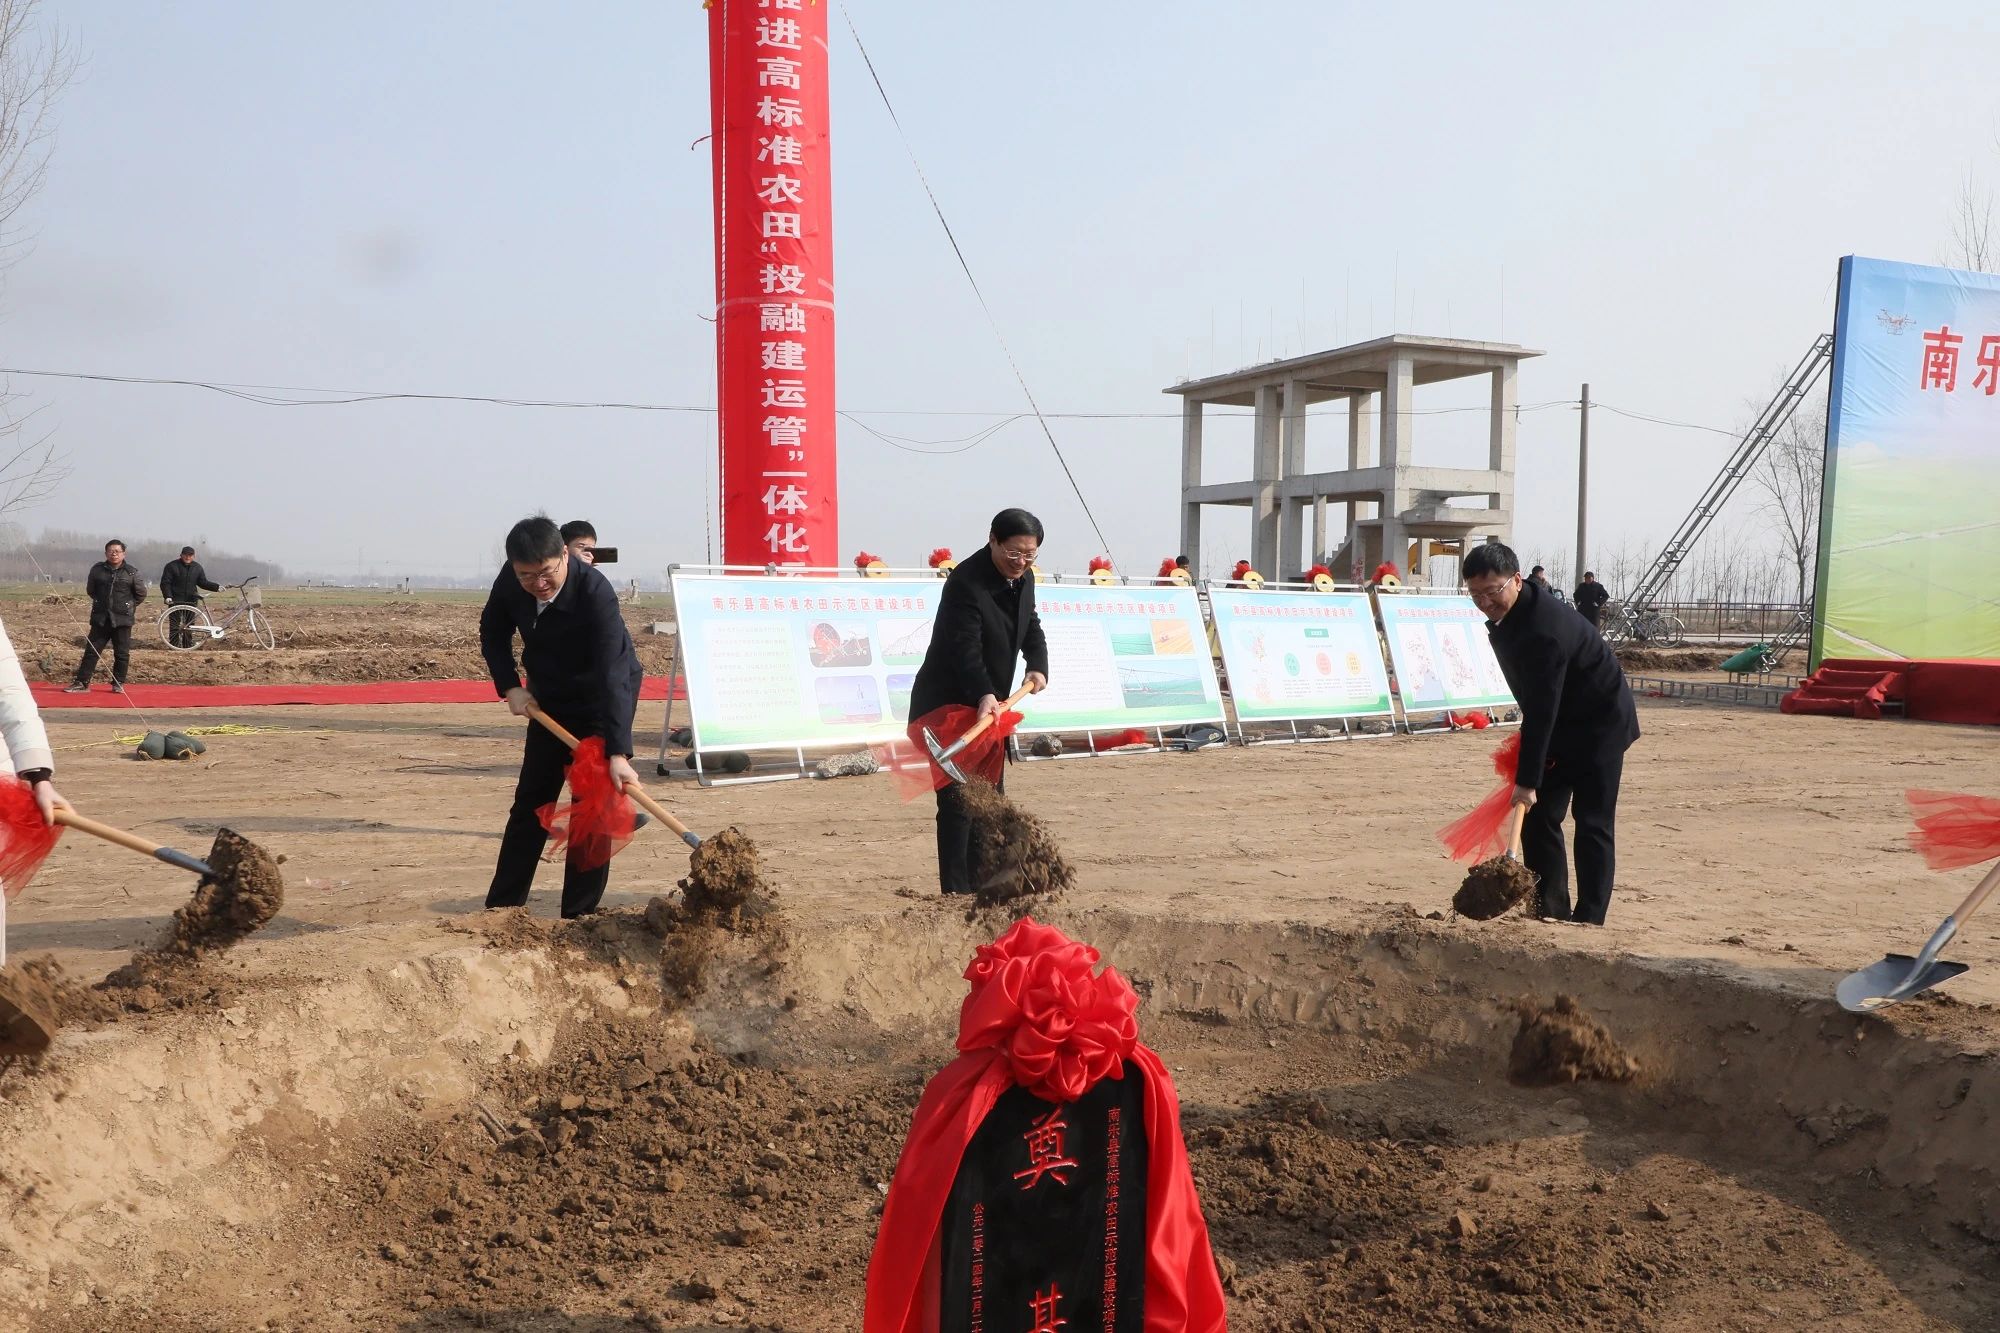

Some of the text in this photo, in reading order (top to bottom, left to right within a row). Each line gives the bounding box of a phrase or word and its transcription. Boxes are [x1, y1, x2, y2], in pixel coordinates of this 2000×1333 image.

[712, 596, 926, 611] 南乐县高标准农田示范区建设项目
